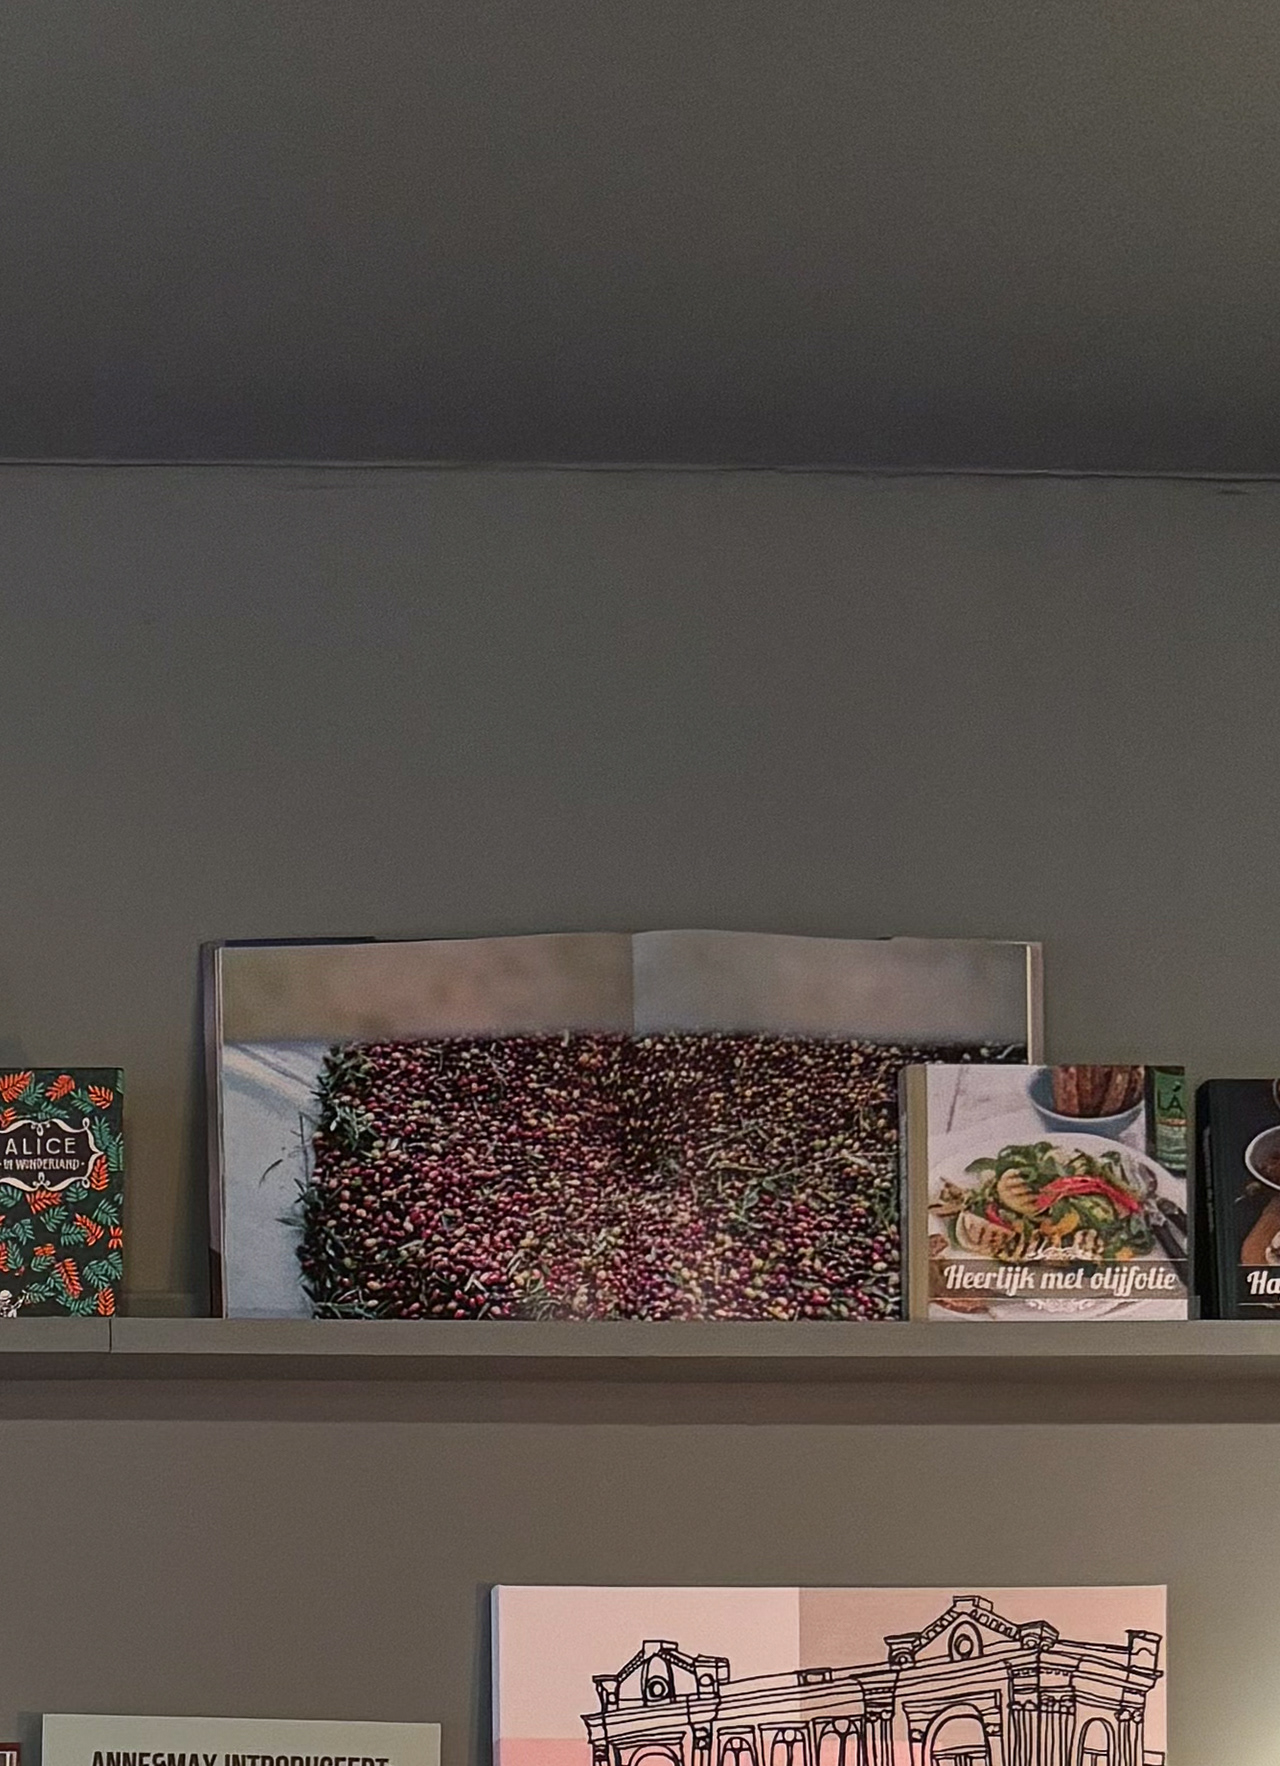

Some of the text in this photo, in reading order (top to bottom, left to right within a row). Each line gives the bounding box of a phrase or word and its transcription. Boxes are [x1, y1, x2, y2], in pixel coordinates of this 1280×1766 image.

[4, 1137, 77, 1156] ALICE
[943, 1264, 1177, 1297] Heerlijk met olijfolie
